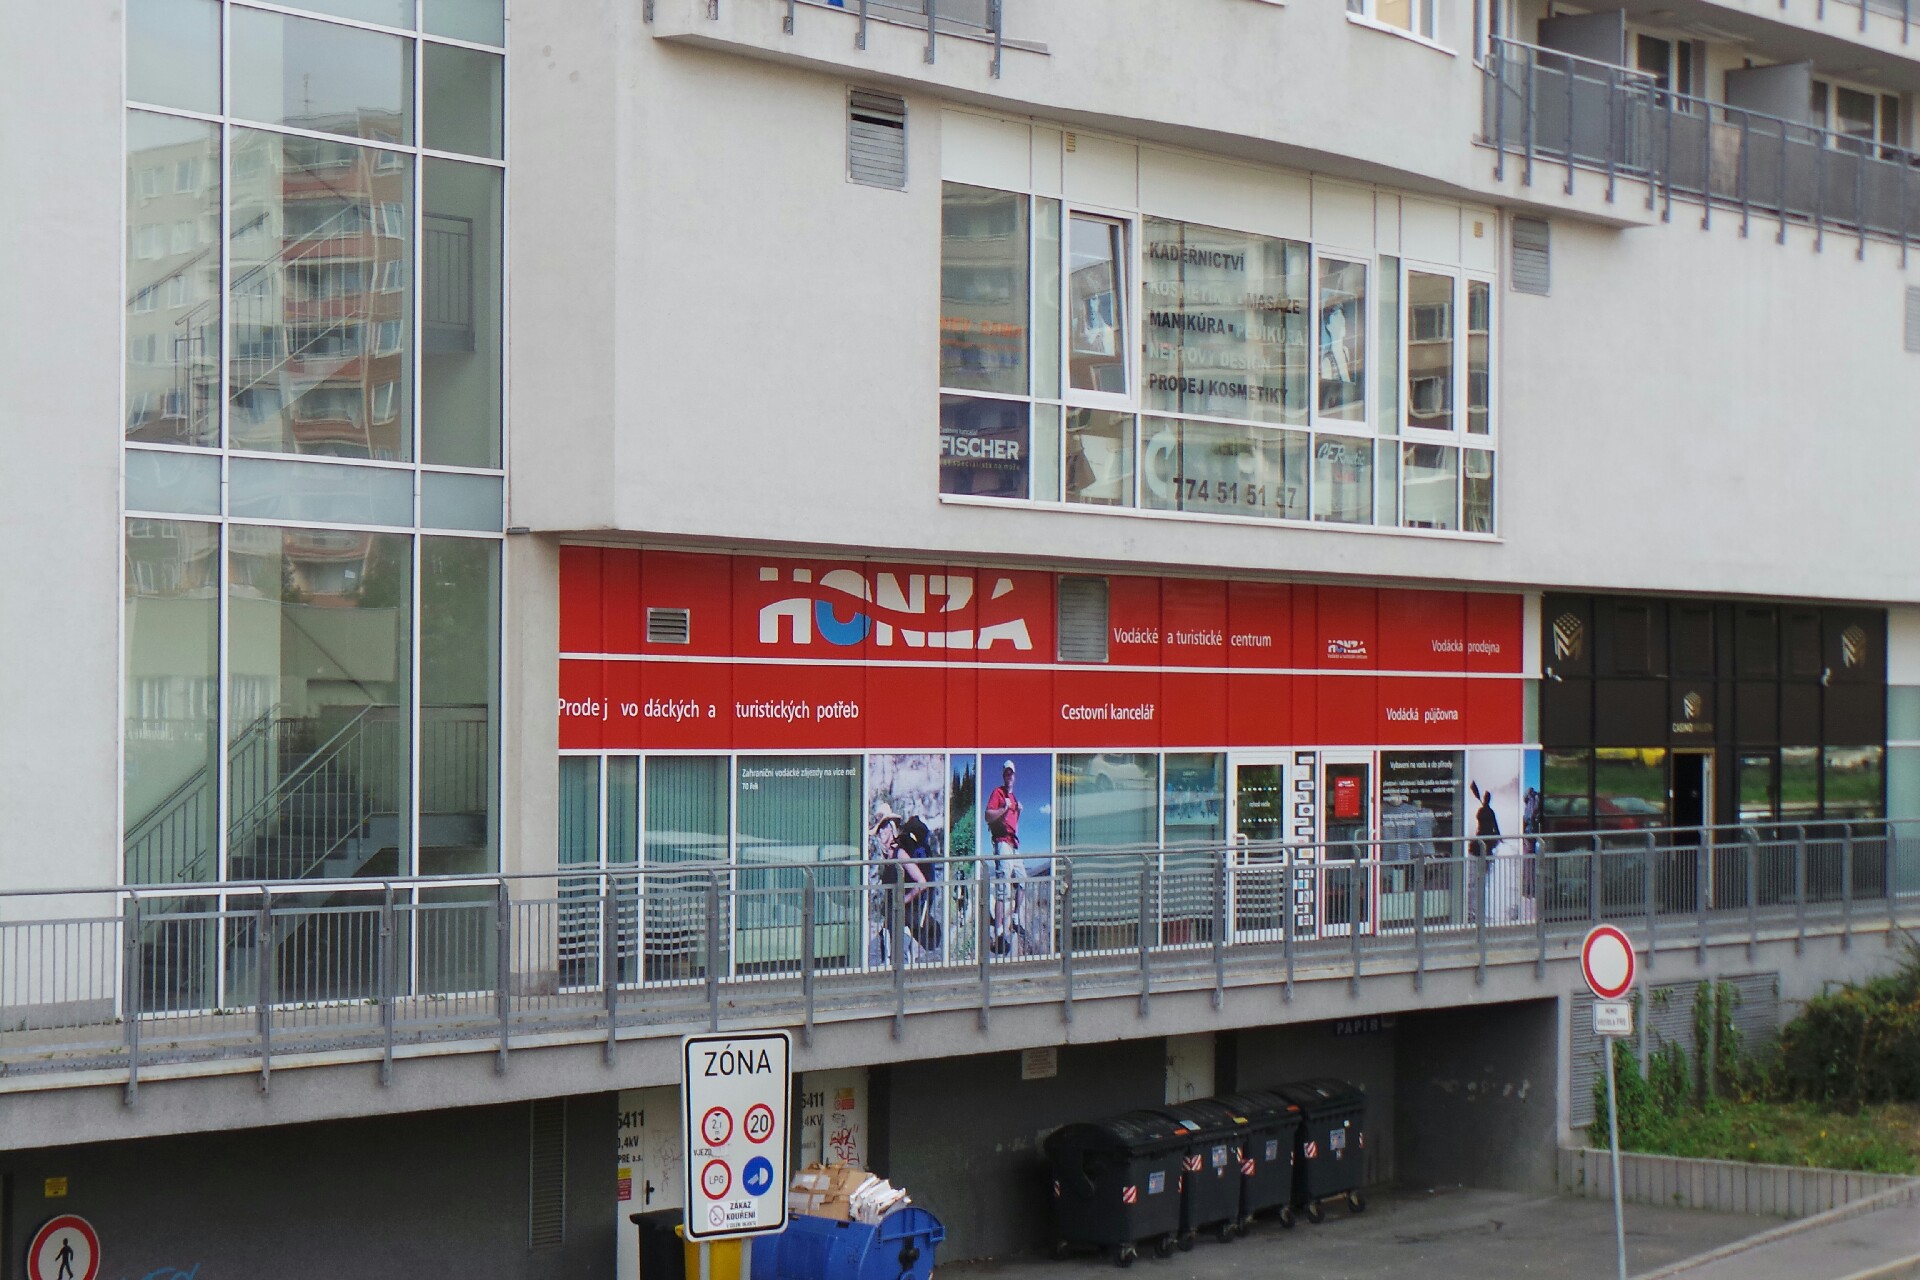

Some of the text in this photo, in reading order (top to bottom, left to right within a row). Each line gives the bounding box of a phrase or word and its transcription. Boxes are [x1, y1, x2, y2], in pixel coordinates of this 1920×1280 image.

[1149, 241, 1245, 272] KADEŘNICTVÍ
[1149, 373, 1204, 396] PRODEJ
[940, 435, 1019, 460] FISCHER
[1172, 477, 1297, 508] 774 51 51 57
[759, 566, 1033, 650] HONZA
[1113, 627, 1272, 647] Vodácké a turistické centrum
[1431, 639, 1500, 656] Vodácká prodejna
[707, 704, 716, 718] a
[735, 700, 810, 723] turistických
[816, 700, 859, 723] potřeb
[1061, 703, 1155, 720] Cestovní kancelář
[1386, 707, 1458, 724] Vodácká půjčovna
[742, 767, 856, 779] Zahraniční vodácké zájezdy na více než
[742, 782, 749, 790] 70
[704, 1044, 772, 1077] ZÓNA
[750, 1114, 769, 1133] 20
[709, 1175, 724, 1185] LPG
